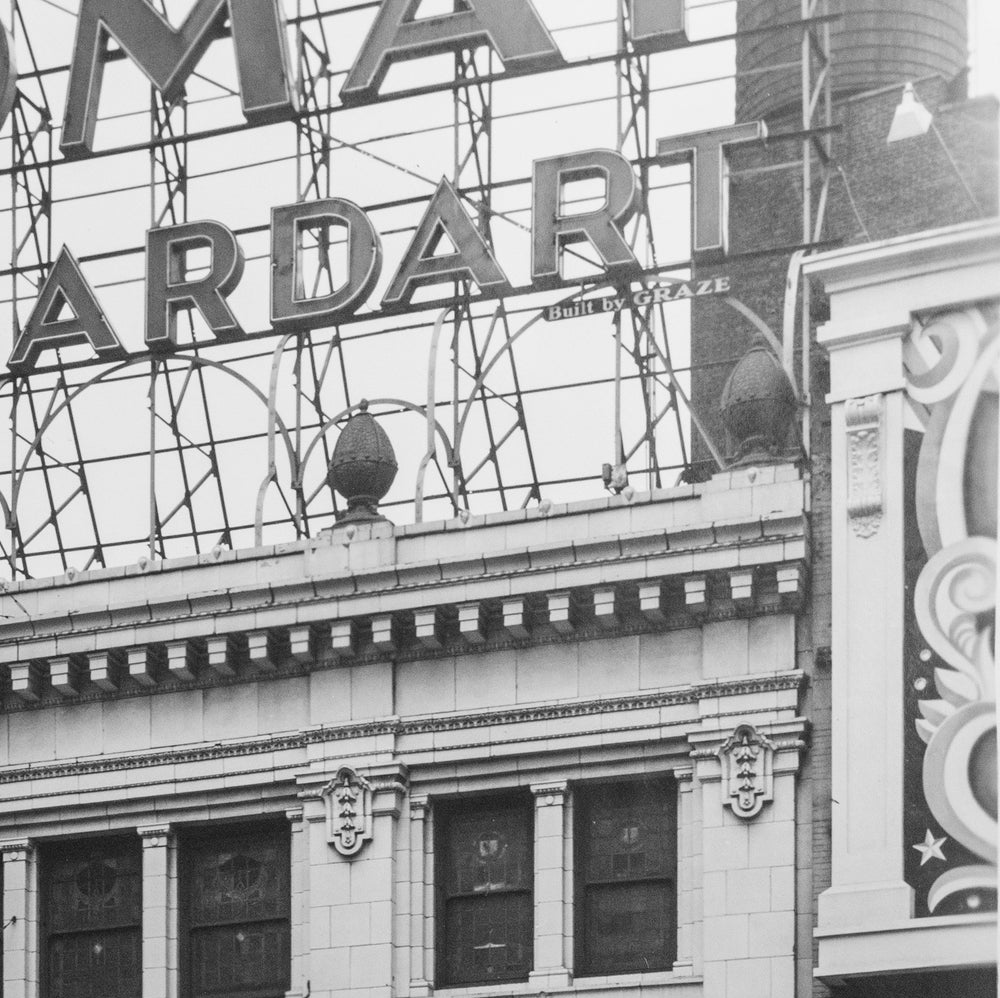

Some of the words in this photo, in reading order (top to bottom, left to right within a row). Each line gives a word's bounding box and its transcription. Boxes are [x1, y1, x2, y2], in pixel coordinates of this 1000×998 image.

[548, 303, 594, 321] Built
[603, 297, 625, 313] by
[632, 276, 732, 306] GRAZE
